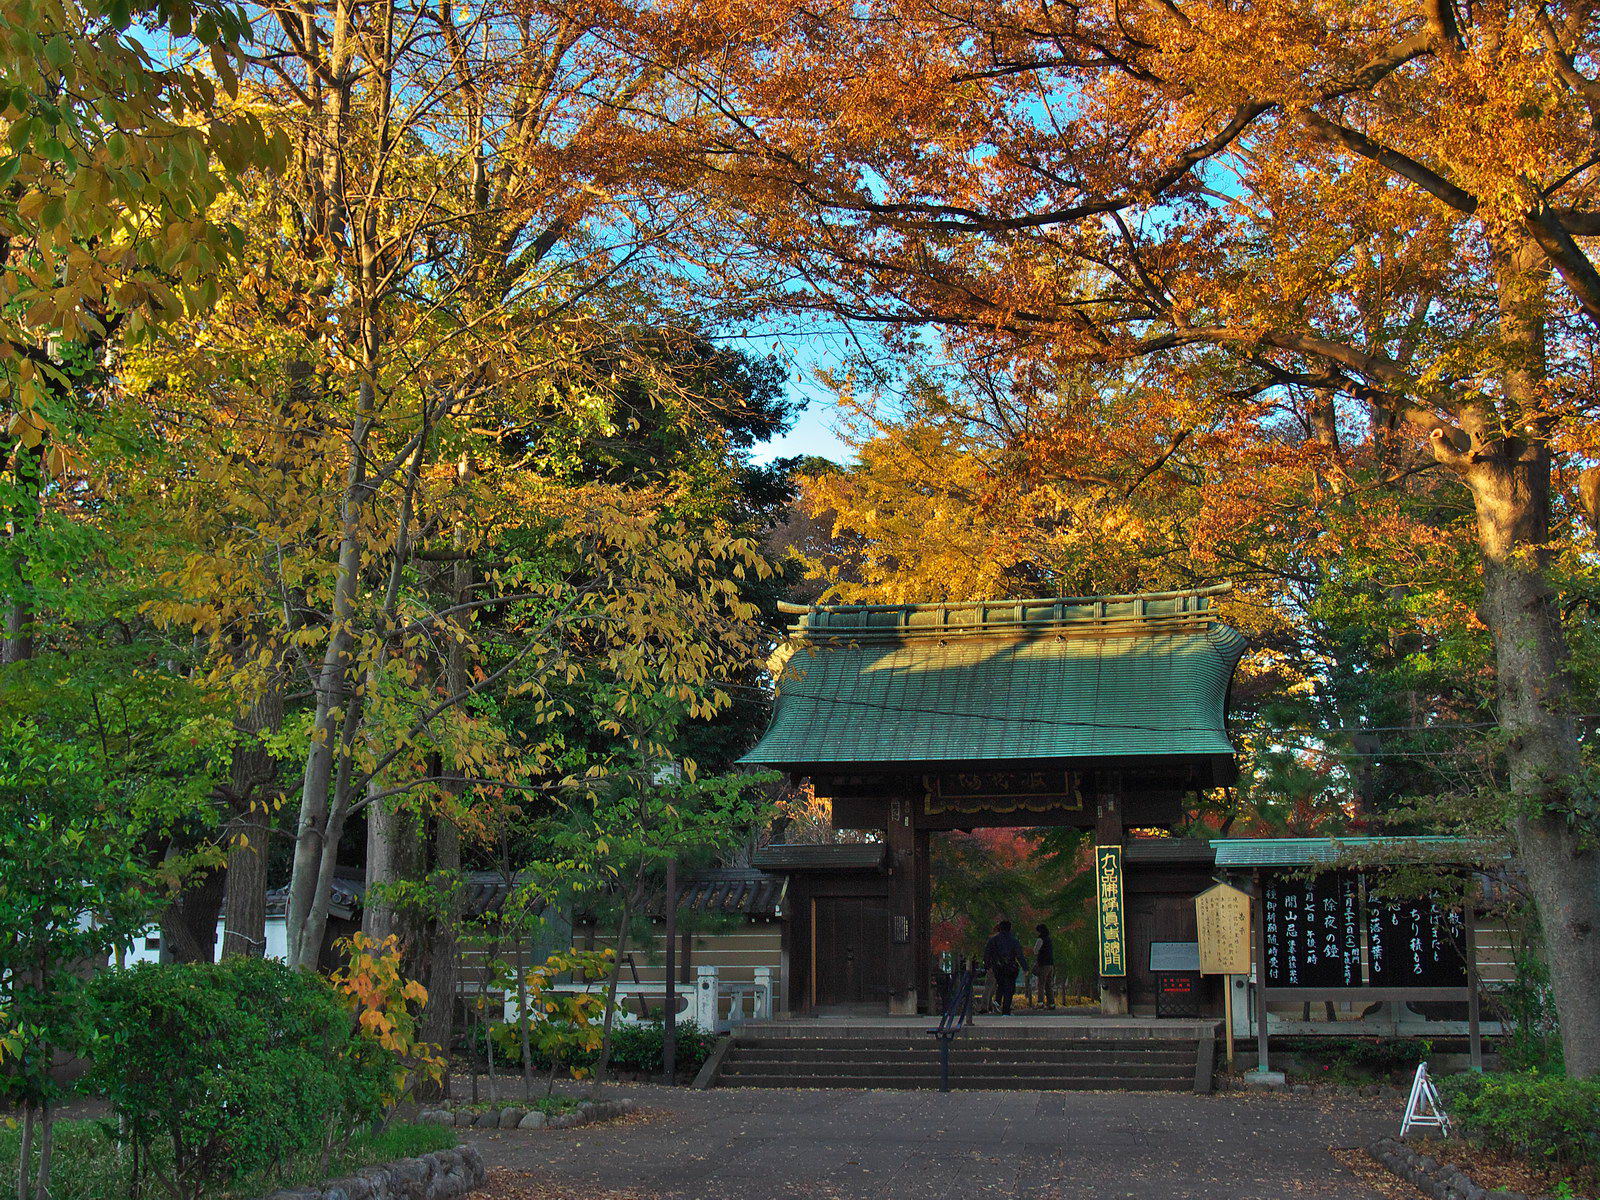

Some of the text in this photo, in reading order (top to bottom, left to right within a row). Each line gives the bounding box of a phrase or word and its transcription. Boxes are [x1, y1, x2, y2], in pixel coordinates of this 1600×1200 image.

[1285, 894, 1298, 937] 開山忌
[1322, 897, 1339, 958] 除夜の鐘
[1410, 908, 1423, 974] ちり積もる
[1306, 930, 1318, 965] 午後一時
